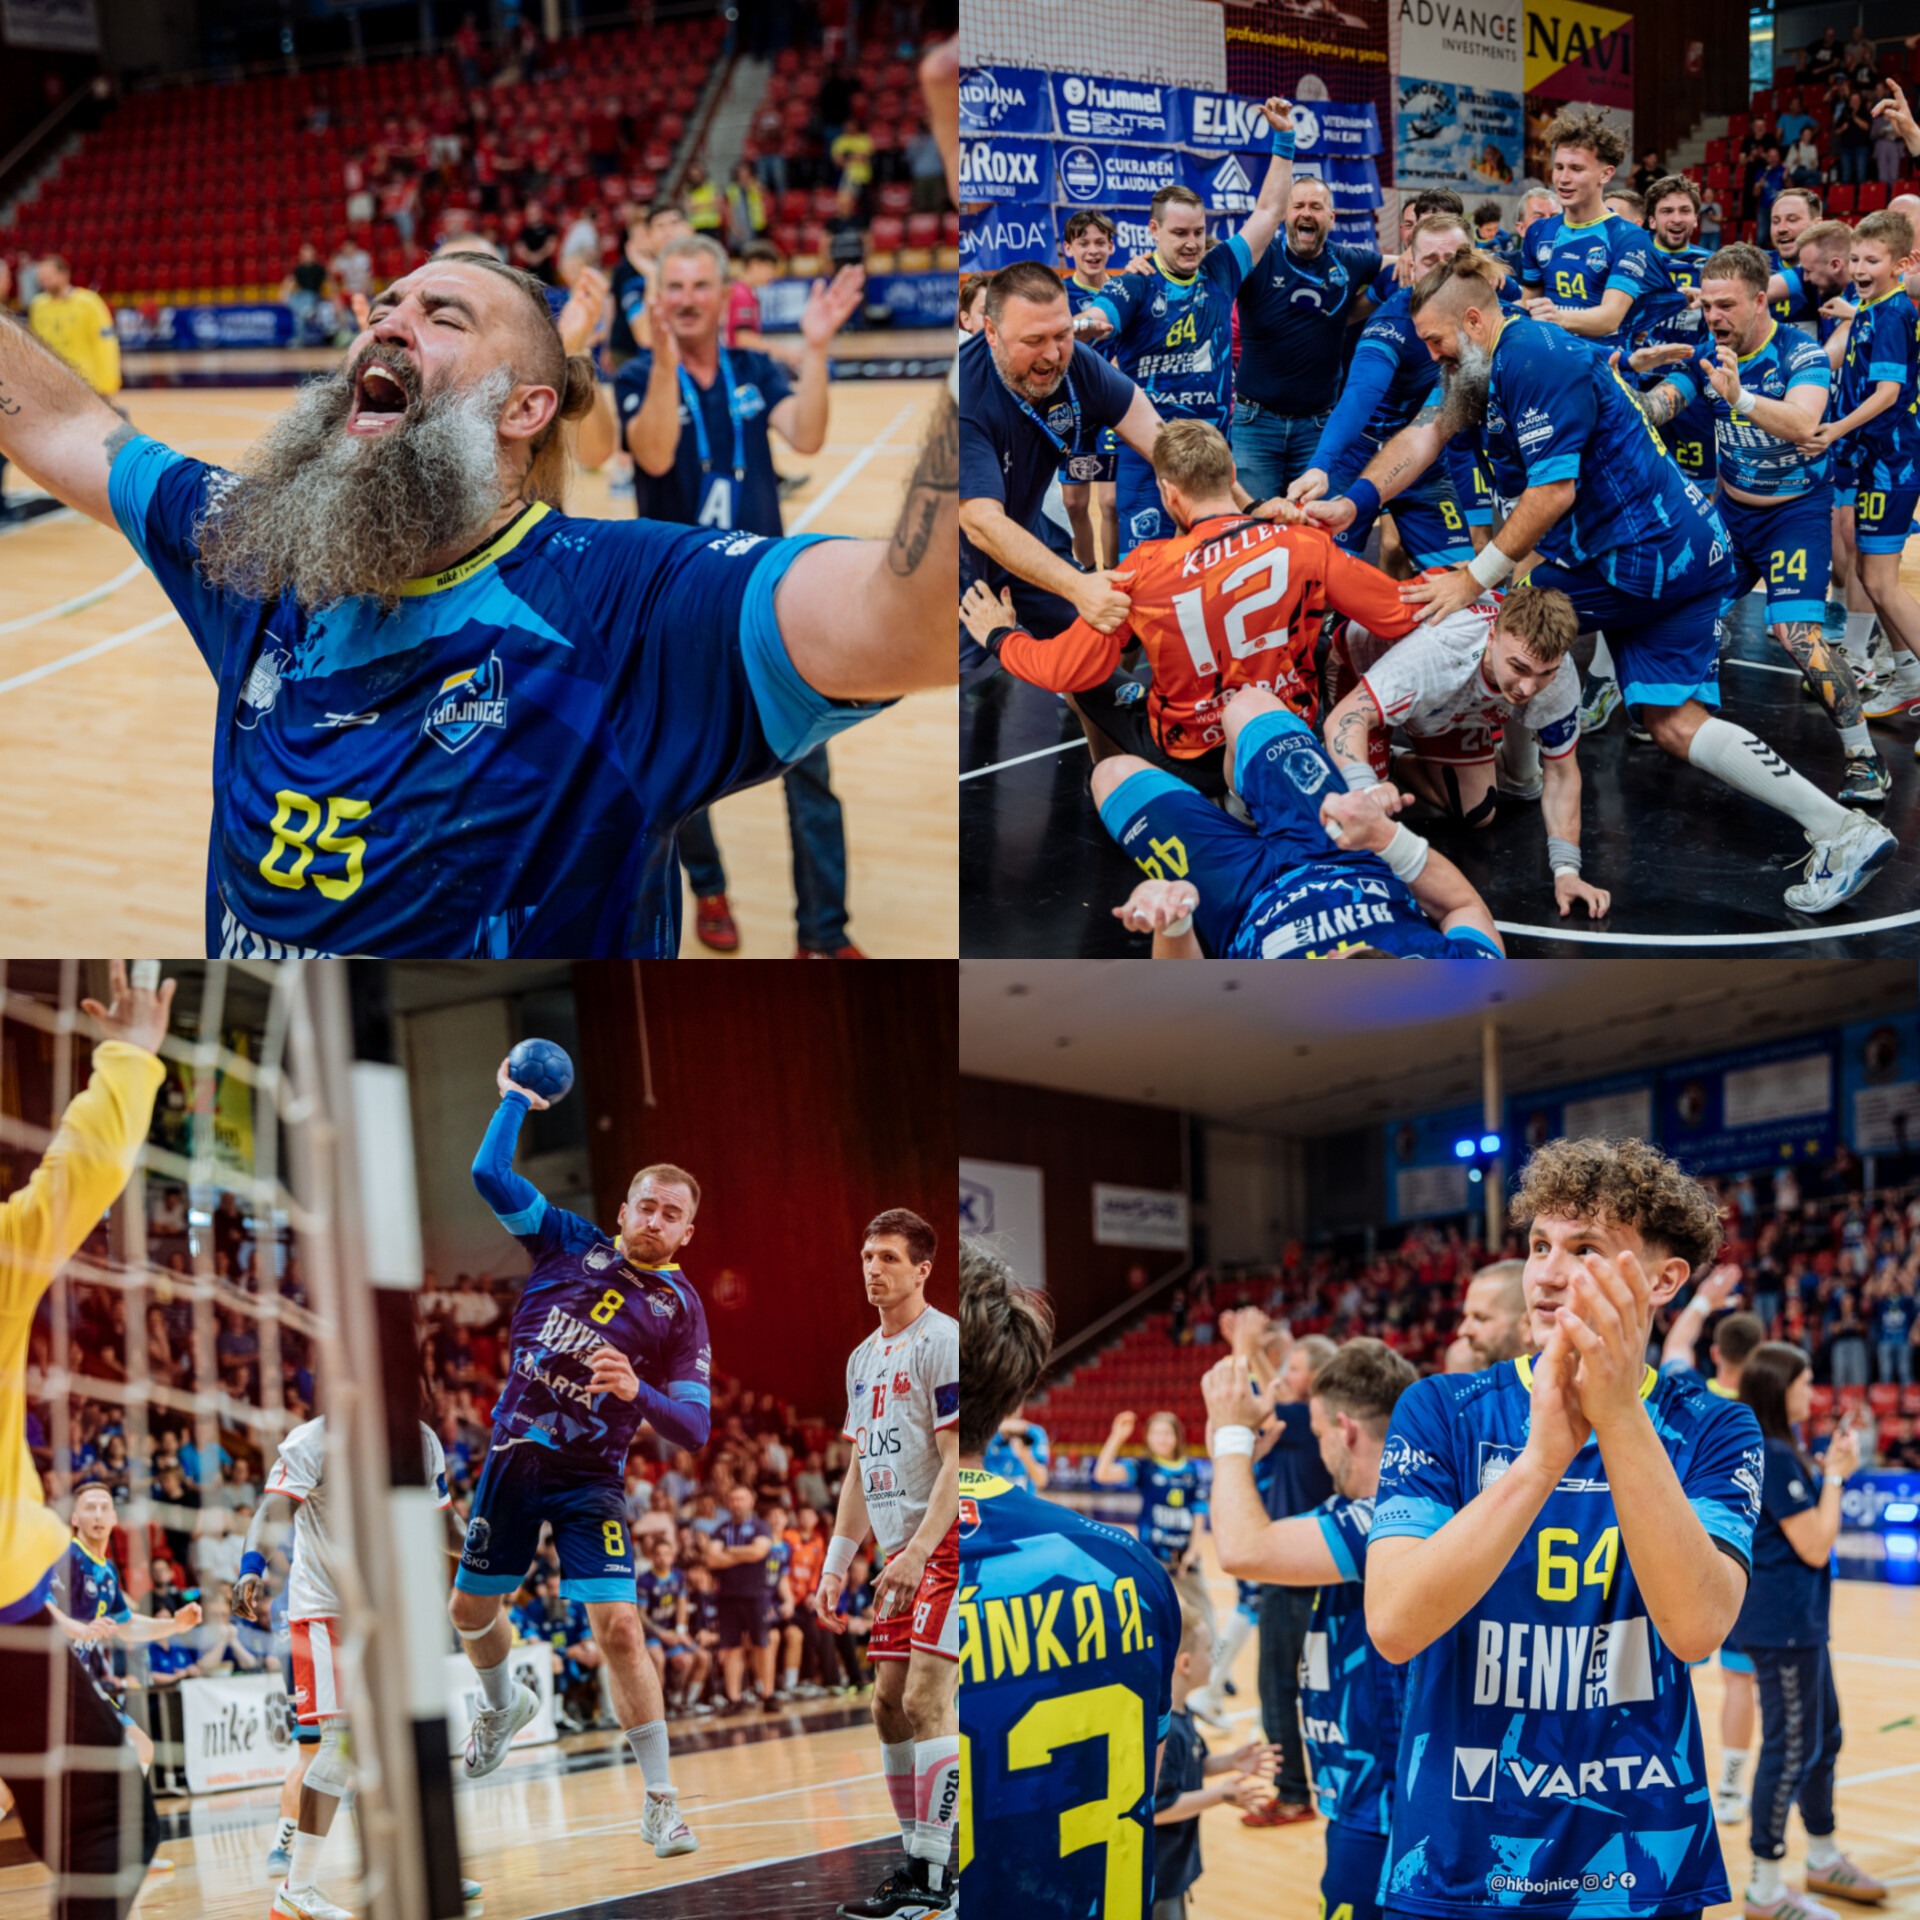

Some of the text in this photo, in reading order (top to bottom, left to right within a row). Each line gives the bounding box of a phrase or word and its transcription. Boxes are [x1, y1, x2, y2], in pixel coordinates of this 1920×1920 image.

[1300, 37, 1338, 56] hygiena
[1340, 48, 1355, 58] pre
[1442, 38, 1517, 63] INVESTMENTS
[1527, 12, 1631, 75] NAVI
[1087, 79, 1162, 113] hummel
[1091, 111, 1166, 131] SINTRA
[1193, 96, 1270, 142] ELKO
[1556, 271, 1588, 300] 64
[1165, 313, 1197, 347] 84
[1149, 391, 1216, 405] VARTA
[698, 478, 732, 530] A
[1439, 501, 1463, 530] 8
[1858, 492, 1886, 520] 30
[1182, 524, 1288, 578] KOLLER
[1770, 549, 1807, 583] 24
[1172, 547, 1289, 677] 12
[260, 789, 372, 901] 85
[1135, 835, 1189, 880] 44
[1255, 879, 1354, 926] VARTA
[590, 1288, 625, 1325] 8
[602, 1520, 627, 1556] 8
[1536, 1526, 1620, 1602] 64
[1113, 1576, 1154, 1654] A.
[1473, 1619, 1590, 1711] BENY
[1508, 1754, 1676, 1798] VARTA
[1491, 1875, 1580, 1896] @hkbojnice
